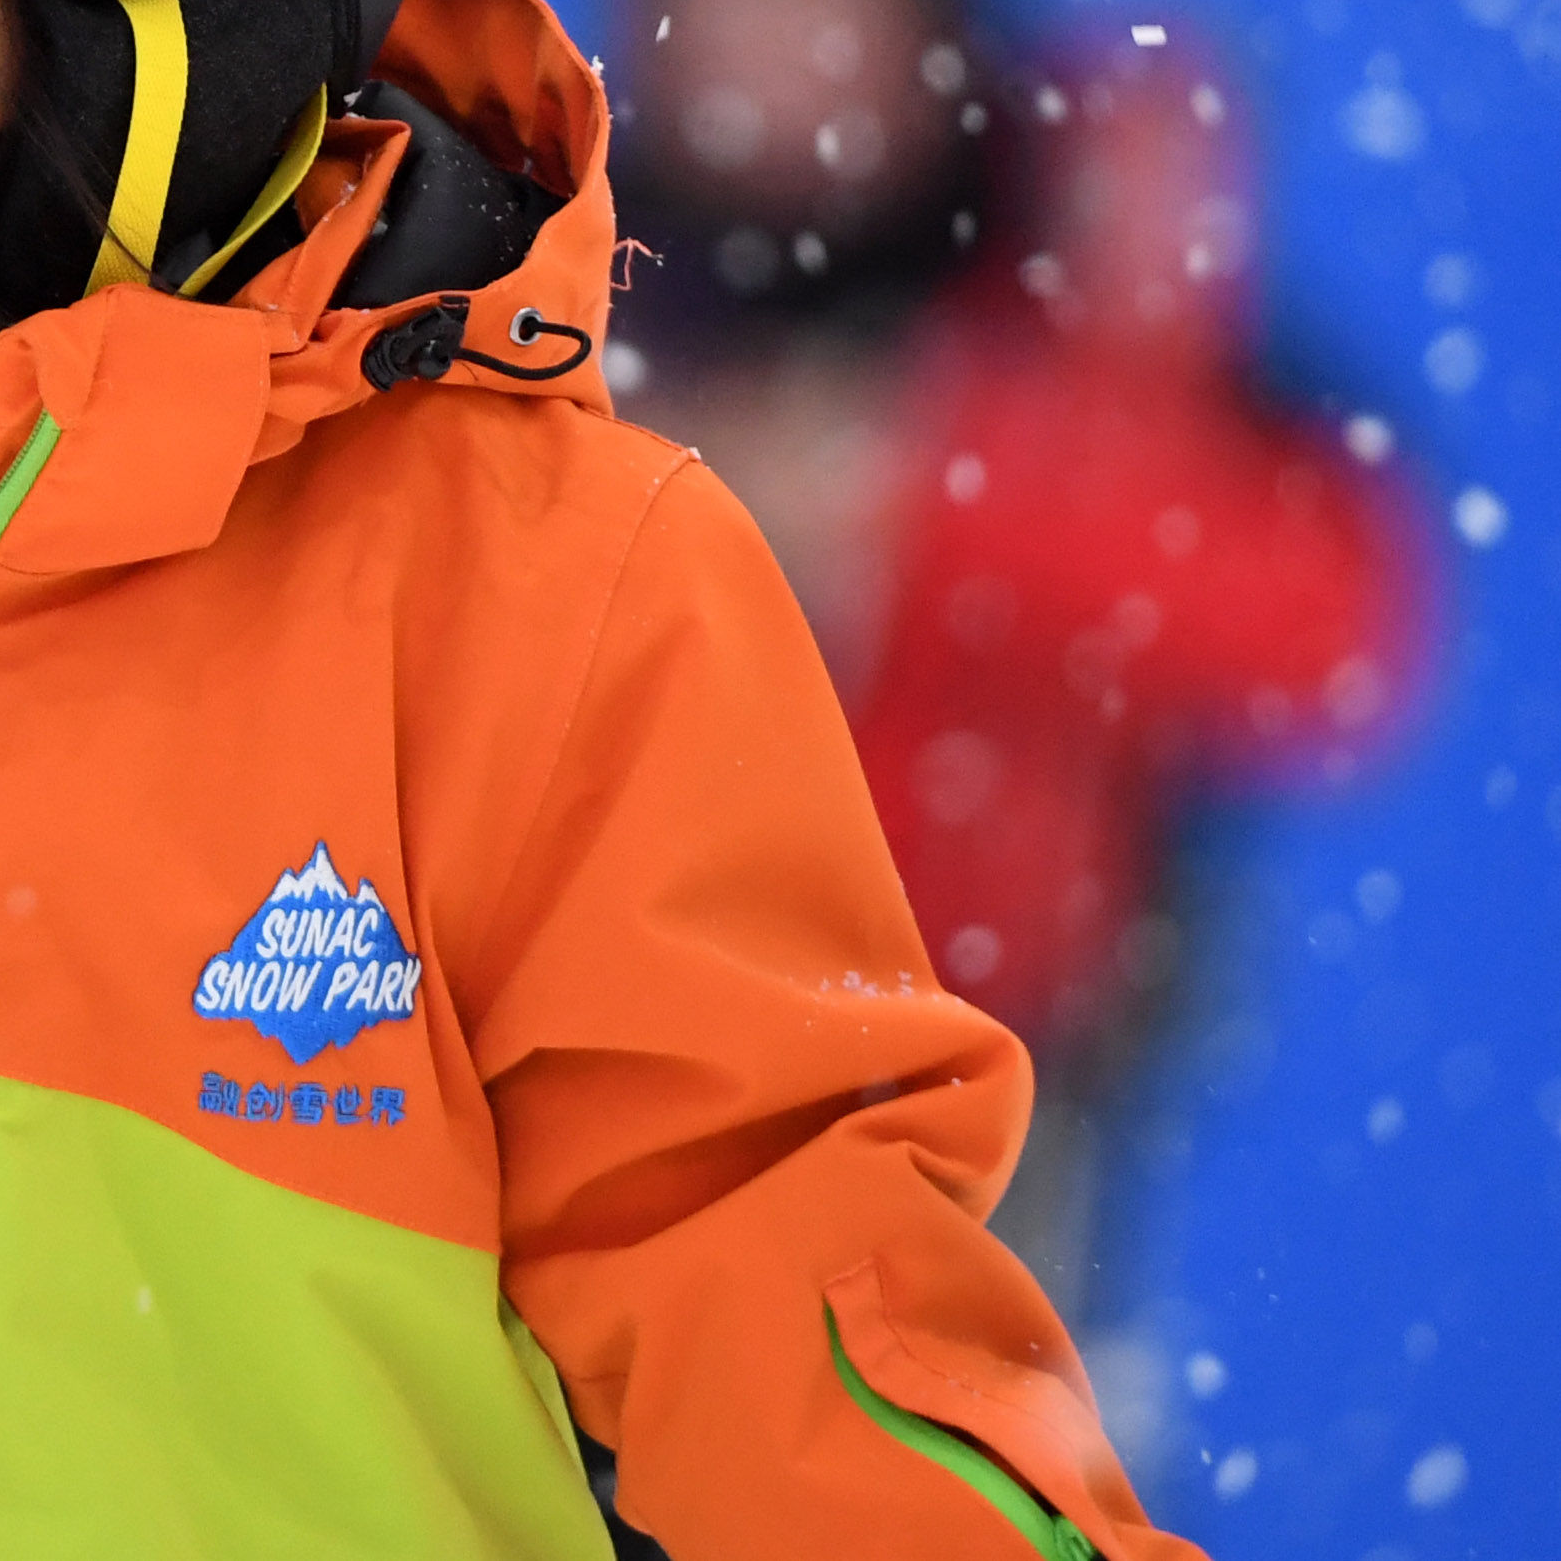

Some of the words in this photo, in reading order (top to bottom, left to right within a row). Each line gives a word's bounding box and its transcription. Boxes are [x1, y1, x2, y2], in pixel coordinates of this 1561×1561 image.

[255, 907, 378, 958] SUNAC
[195, 960, 323, 1013] SNOW
[322, 957, 422, 1012] PARK
[199, 1071, 406, 1126] 融创雪世界
